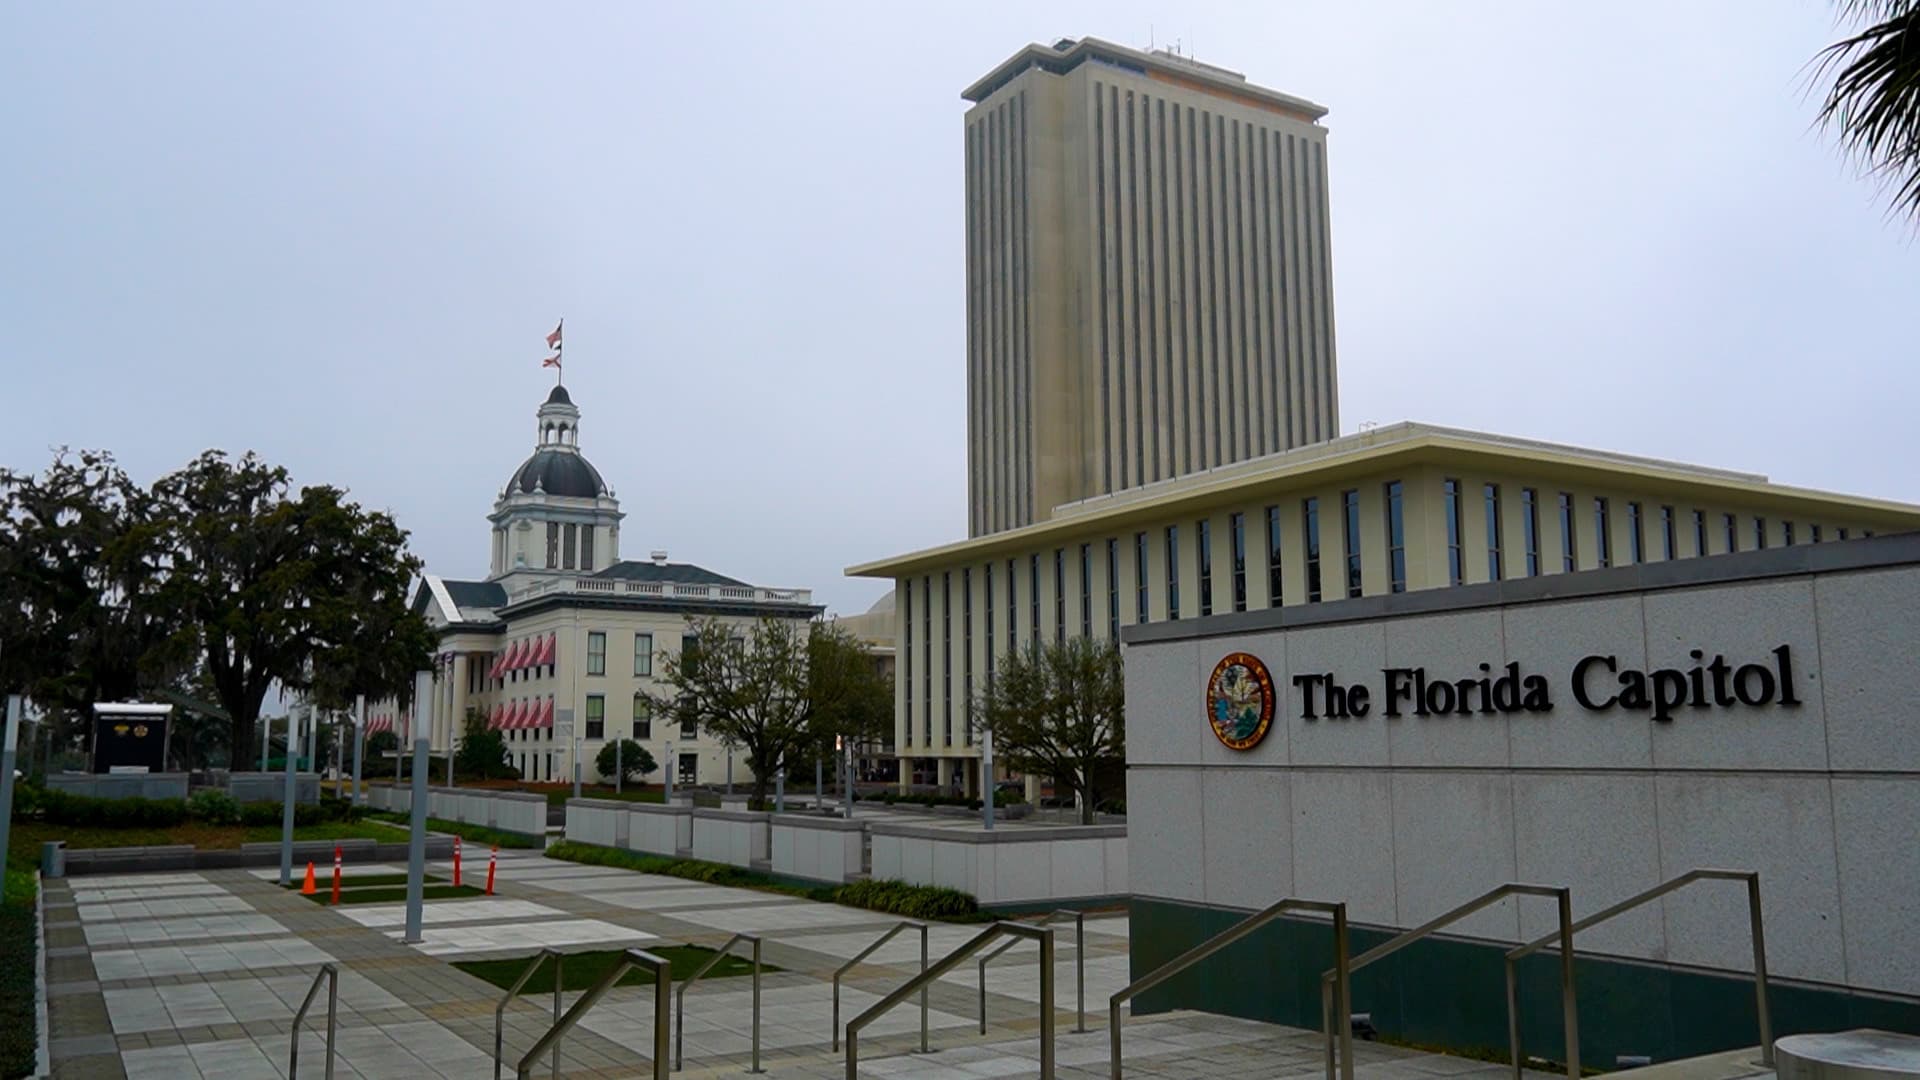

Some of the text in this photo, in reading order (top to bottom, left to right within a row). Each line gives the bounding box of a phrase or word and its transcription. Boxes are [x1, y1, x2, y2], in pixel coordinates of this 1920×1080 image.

[1293, 673, 1370, 719] The
[1381, 661, 1554, 717] Florida
[1571, 644, 1803, 722] Capitol
